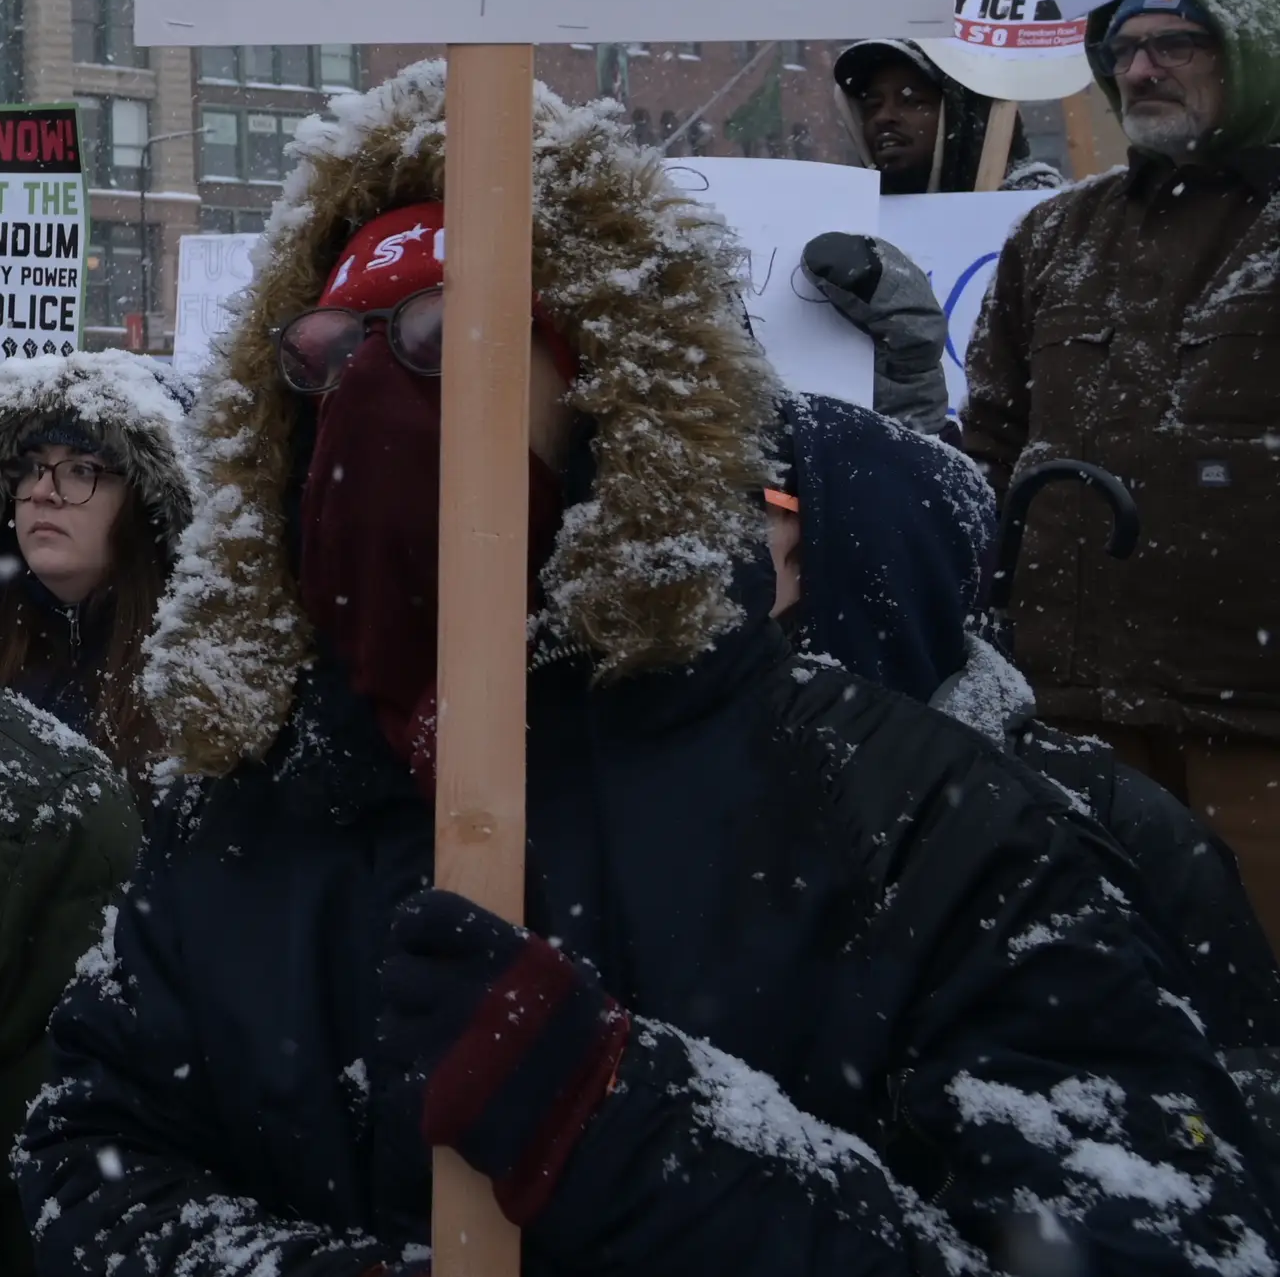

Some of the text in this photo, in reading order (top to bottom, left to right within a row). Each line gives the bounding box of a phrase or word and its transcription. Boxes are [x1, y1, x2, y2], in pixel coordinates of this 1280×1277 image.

[23, 181, 79, 216] THE
[21, 266, 78, 288] POWER
[181, 239, 247, 283] FUC
